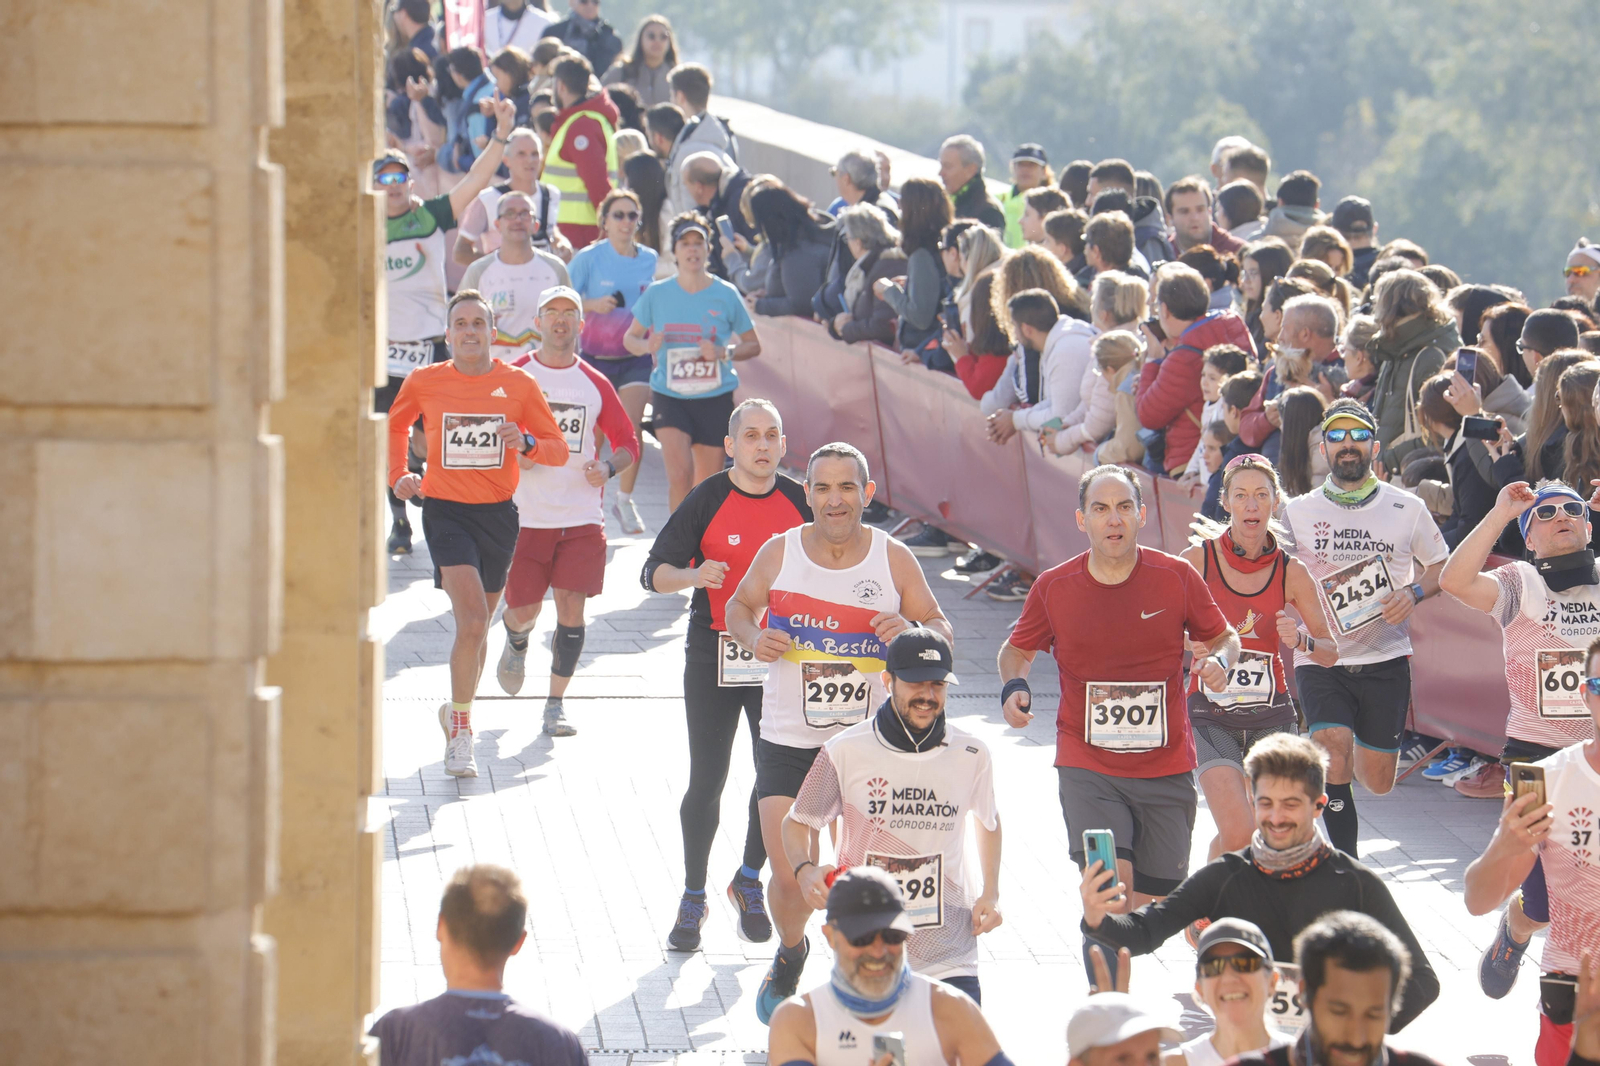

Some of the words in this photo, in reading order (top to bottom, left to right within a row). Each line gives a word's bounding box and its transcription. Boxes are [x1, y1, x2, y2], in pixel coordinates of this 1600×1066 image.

[388, 347, 426, 365] 2767
[672, 361, 716, 378] 4957
[450, 431, 498, 448] 4421
[1333, 529, 1372, 540] MEDIA
[1314, 538, 1329, 550] 37
[1333, 539, 1394, 553] MARATÓN
[1331, 573, 1388, 611] 2434
[1559, 601, 1597, 614] MEDIA
[789, 613, 840, 630] Club
[793, 635, 816, 652] La
[821, 637, 881, 656] Bestia
[1544, 670, 1585, 691] 60
[807, 682, 867, 703] 2996
[1094, 704, 1159, 726] 3907
[892, 787, 938, 801] MEDIA
[868, 800, 887, 815] 37
[891, 801, 959, 818] MARATÓN
[889, 818, 938, 831] CÓRDOBA
[1570, 830, 1592, 846] 37
